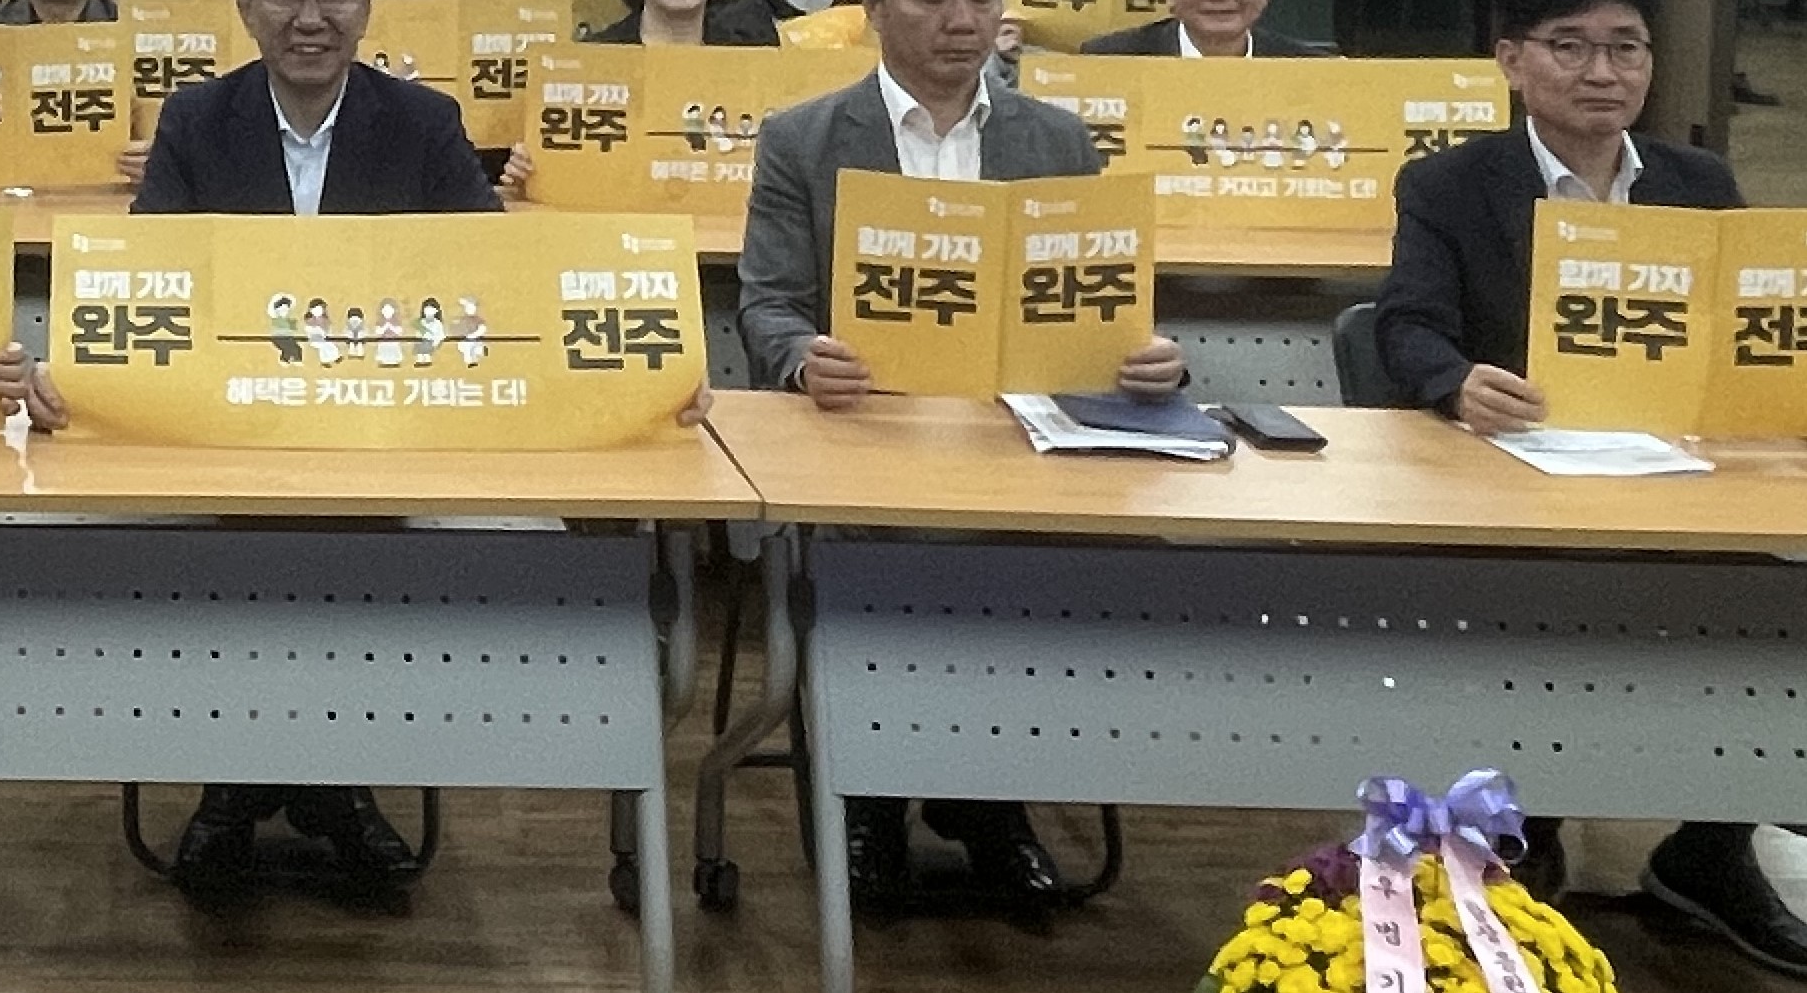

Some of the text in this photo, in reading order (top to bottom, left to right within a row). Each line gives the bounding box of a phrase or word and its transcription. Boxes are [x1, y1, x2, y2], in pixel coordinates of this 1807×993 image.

[31, 89, 114, 133] 전주
[540, 108, 628, 152] 완주
[921, 234, 982, 263] 가자
[1085, 229, 1139, 258] 가자
[136, 271, 192, 299] 가자
[622, 272, 678, 301] 가자
[853, 263, 978, 325] 전주
[1020, 264, 1137, 324] 완주
[1627, 265, 1692, 294] 가자
[72, 306, 192, 366] 완주
[562, 309, 683, 370] 전주
[1554, 295, 1689, 362] 완주
[226, 377, 527, 407] 혜택은 커지고 기회는 더!
